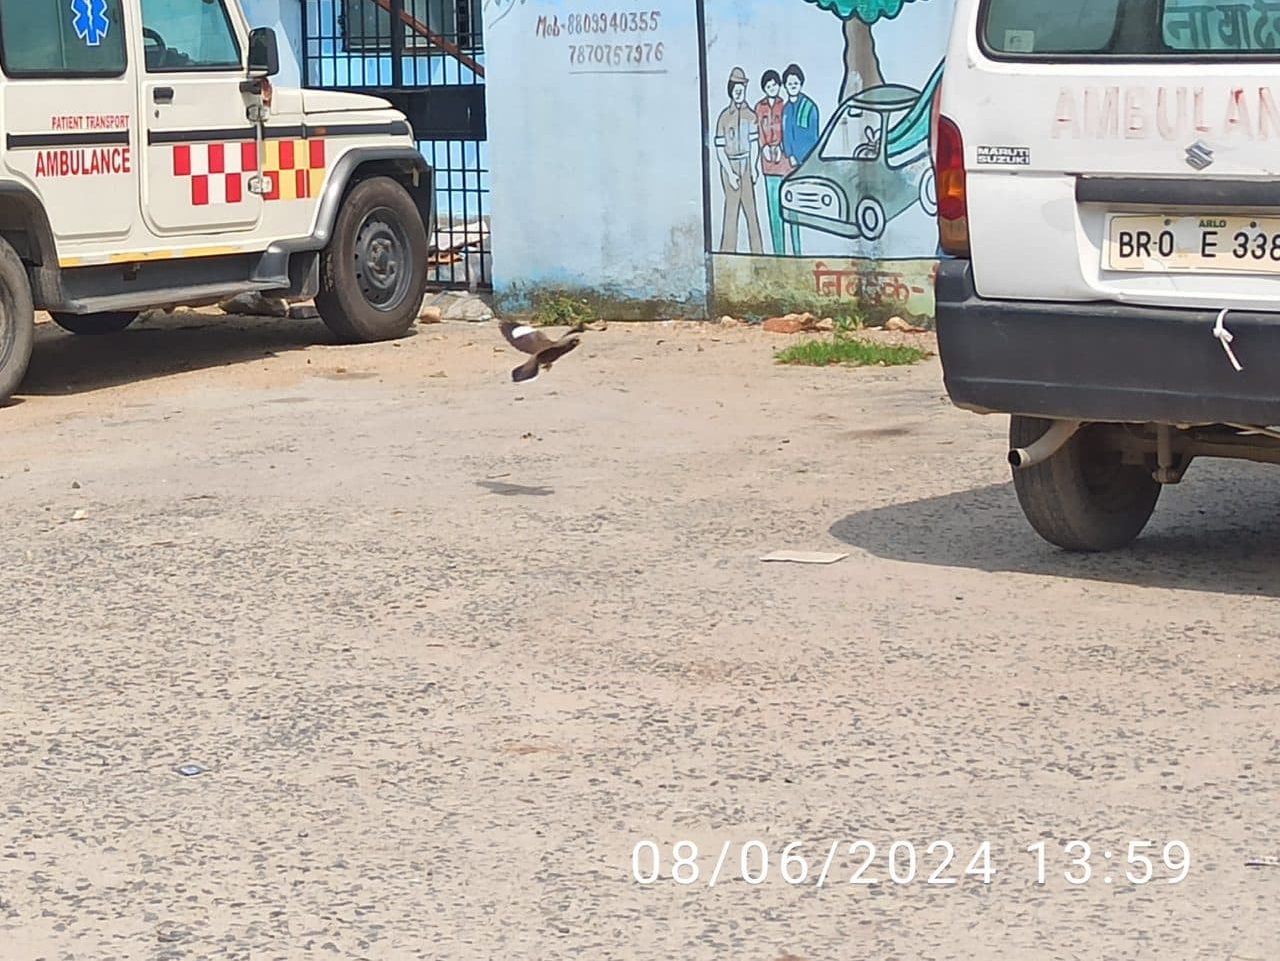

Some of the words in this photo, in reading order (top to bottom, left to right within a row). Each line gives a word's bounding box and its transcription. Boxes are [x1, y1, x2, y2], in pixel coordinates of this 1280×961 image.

[51, 115, 84, 130] PATIENT
[85, 114, 130, 130] TRANSPORT
[977, 147, 1030, 156] MARUTI
[34, 147, 131, 178] AMBULANCE
[977, 155, 1030, 165] SUZUKI
[1201, 230, 1219, 259] E
